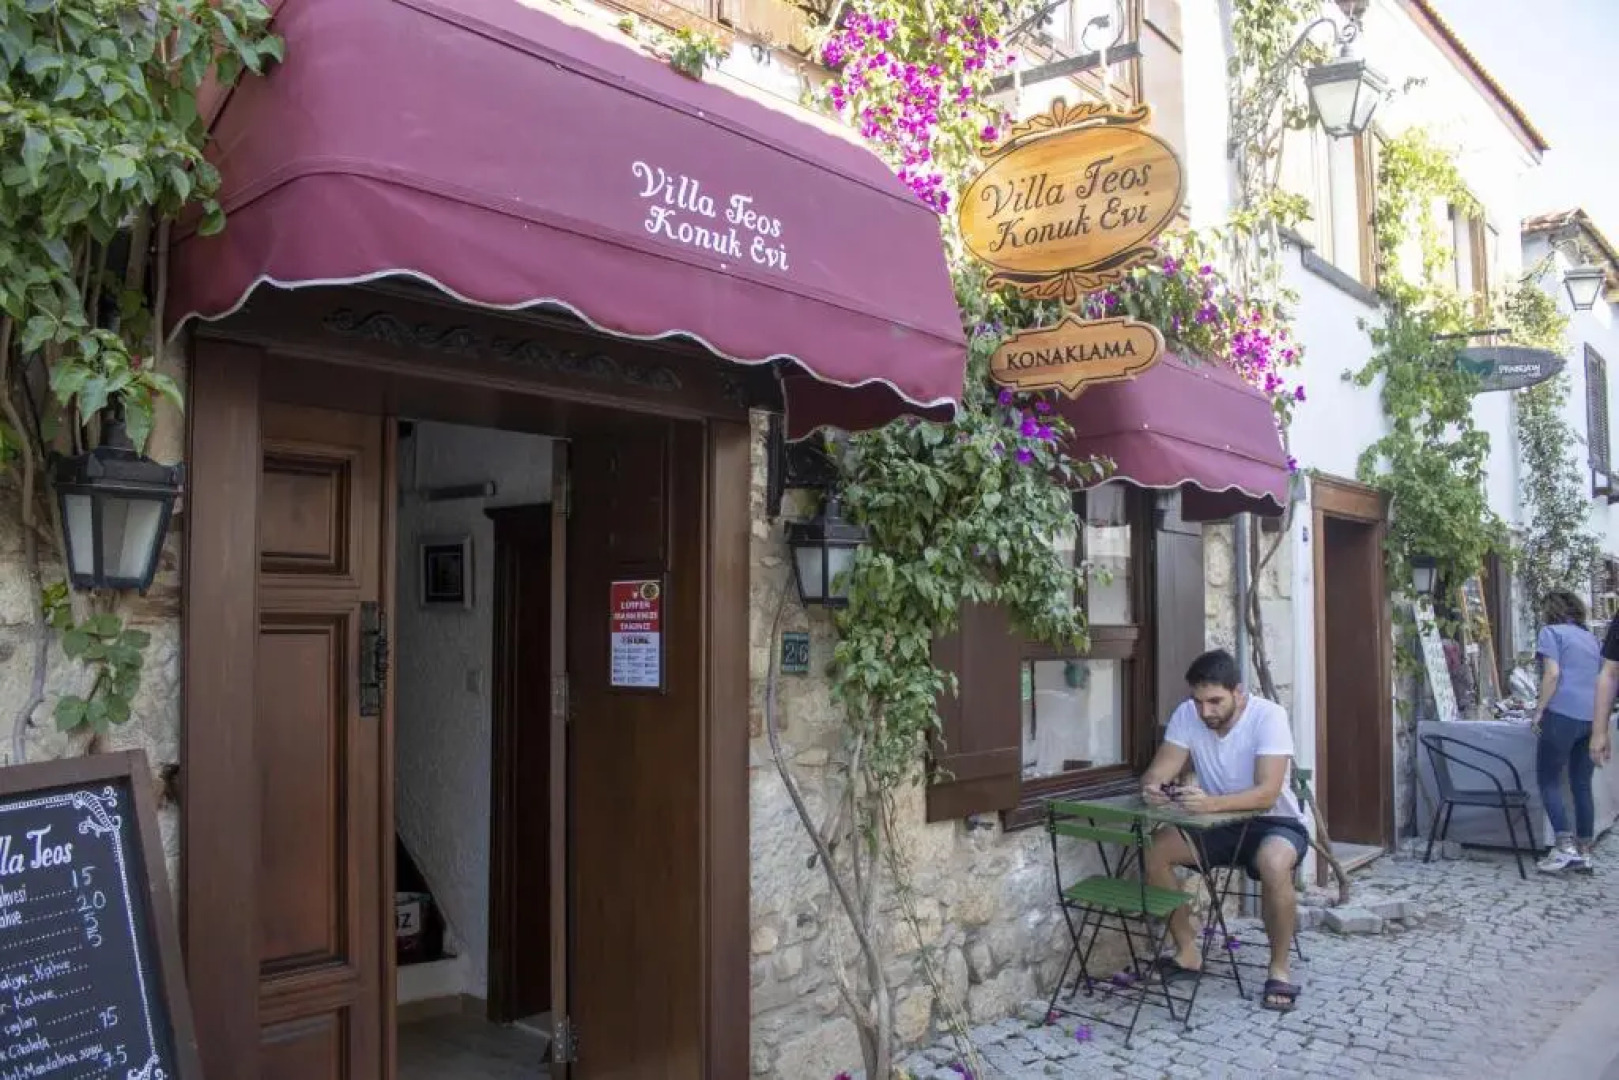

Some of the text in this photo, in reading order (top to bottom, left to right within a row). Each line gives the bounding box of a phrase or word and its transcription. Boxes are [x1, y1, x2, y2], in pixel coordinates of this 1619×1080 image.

[632, 160, 782, 238] Villa Teos
[981, 155, 1152, 220] Villa Teos
[645, 205, 790, 271] Konuk Evi
[989, 190, 1149, 252] Konuk Evi
[1006, 339, 1137, 370] KONAKLAMA
[26, 823, 73, 869] Teos
[77, 890, 106, 912] 20
